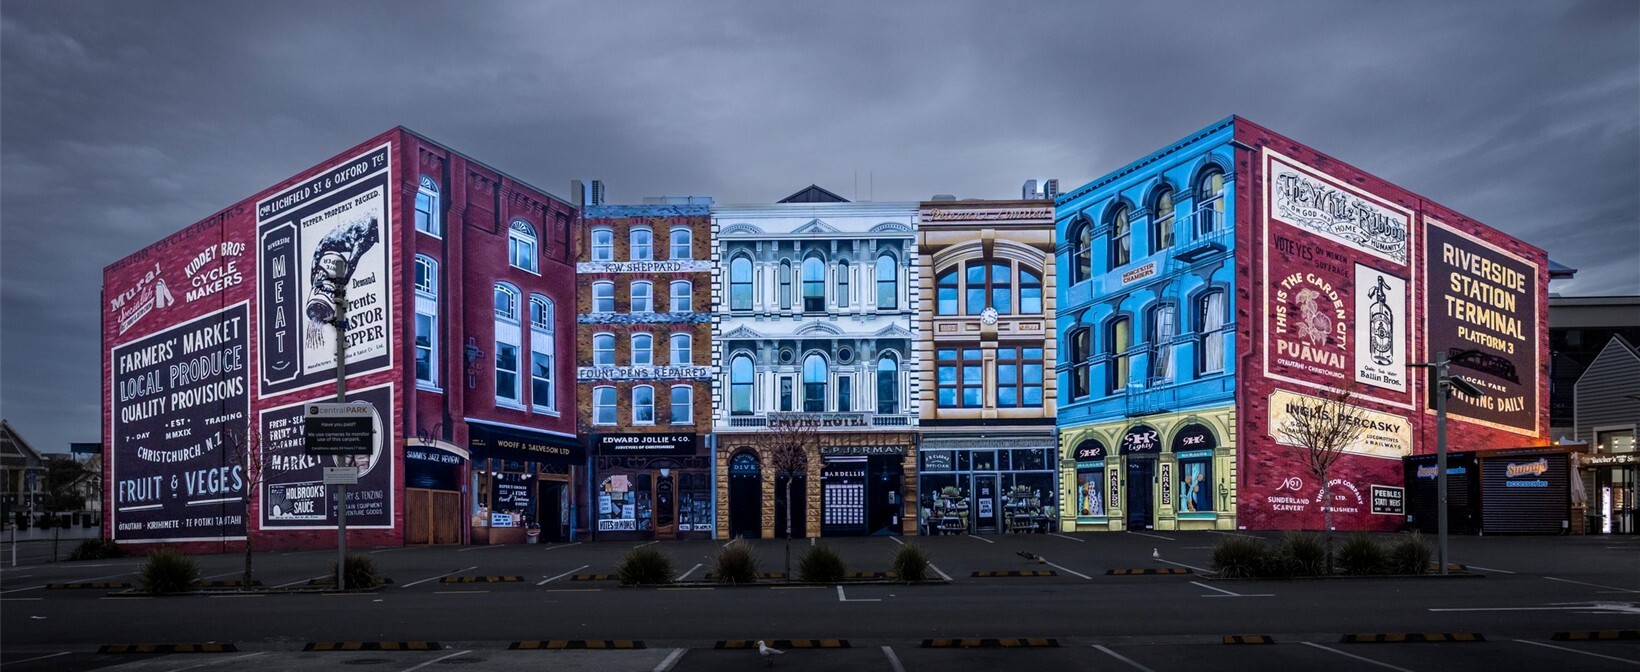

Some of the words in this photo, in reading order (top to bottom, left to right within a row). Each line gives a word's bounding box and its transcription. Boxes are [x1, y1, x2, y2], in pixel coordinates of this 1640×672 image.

[272, 188, 310, 213] LICHFIELD
[325, 178, 332, 188] &
[334, 162, 368, 184] OXFORD
[303, 215, 324, 228] PEPPER
[324, 202, 352, 220] PROPERLY
[994, 206, 1048, 220] Limited
[1279, 174, 1309, 203] The
[1306, 181, 1356, 221] White
[1352, 202, 1406, 242] Ribbon
[1302, 209, 1318, 218] GOD
[268, 237, 290, 250] RIVERSIDE
[1334, 226, 1357, 234] HOME
[1370, 239, 1400, 251] HUMANITY
[1274, 234, 1294, 255] VOTE
[1296, 242, 1313, 261] YES
[1316, 246, 1323, 254] ON
[1326, 250, 1348, 264] WOMEN
[184, 244, 218, 278] KIDDEY
[626, 262, 681, 272] SHEPPARD
[1315, 260, 1349, 278] SUFFRAGE
[1443, 242, 1526, 294] RIVERSIDE
[192, 260, 237, 288] CYCLE
[1122, 262, 1154, 278] WORCESTER
[1123, 270, 1154, 284] CHAMBERS
[111, 262, 162, 312] Mural
[186, 272, 242, 303] MAKERS
[352, 272, 376, 289] Demand
[1281, 272, 1302, 290] THE
[1277, 290, 1288, 304] IS
[1306, 273, 1346, 320] GARDEN
[1450, 272, 1516, 313] STATION
[272, 254, 286, 353] MEAT
[344, 293, 376, 312] rents
[345, 307, 384, 332] ASTOR
[1276, 304, 1286, 333] THIS
[1445, 294, 1526, 341] TERMINAL
[344, 325, 384, 349] EPPER
[1337, 322, 1346, 350] CITY
[1458, 326, 1506, 352] PLATFORM
[1507, 342, 1514, 354] 3
[120, 338, 177, 374] FARMERS'
[182, 316, 240, 355] MARKET
[1278, 339, 1345, 369] PUĀWAI
[120, 370, 164, 402] LOCAL
[170, 344, 242, 388] PRODUCE
[580, 370, 618, 378] FOUNT
[620, 369, 648, 378] PENS
[654, 368, 706, 377] REPAIRED
[1308, 366, 1344, 378] CHRISTCHURCH
[1360, 370, 1382, 382] Ballin
[1462, 376, 1486, 386] LOCAL
[122, 396, 166, 424] QUALITY
[171, 376, 244, 412] PROVISIONS
[1498, 396, 1524, 412] DAILY
[205, 412, 242, 426] TRADING
[270, 418, 287, 430] FRESH
[292, 414, 306, 424] SEA
[769, 414, 820, 428] EMPIRE
[823, 414, 868, 426] HOTEL
[1338, 413, 1400, 433] PERCASKY
[165, 428, 192, 440] MMXIX
[270, 428, 291, 441] FRUIT
[641, 436, 670, 444] JOLLIE
[528, 444, 559, 454] SALVESON
[560, 447, 570, 456] LTD
[845, 446, 904, 454] JERMAN
[1370, 440, 1402, 450] RAILWAYS
[428, 452, 440, 462] JAZZ
[441, 454, 460, 464] REVIEW
[824, 470, 865, 478] BARDELLIS
[1506, 458, 1548, 478] Sunny's
[120, 476, 163, 502] FRUIT
[170, 474, 178, 490] &
[185, 464, 242, 496] VEGES
[1162, 465, 1170, 504] HARALDS
[286, 485, 324, 500] HOLBROOK'S
[355, 492, 360, 500] &
[362, 490, 383, 500] TENZING
[1268, 496, 1310, 504] SUNDERLAND
[1342, 480, 1363, 504] COMPANY
[1374, 490, 1402, 498] PEEBLES
[294, 500, 314, 514] SAUCE
[147, 520, 180, 530] KIRIHIMETE
[600, 520, 614, 530] VOTES
